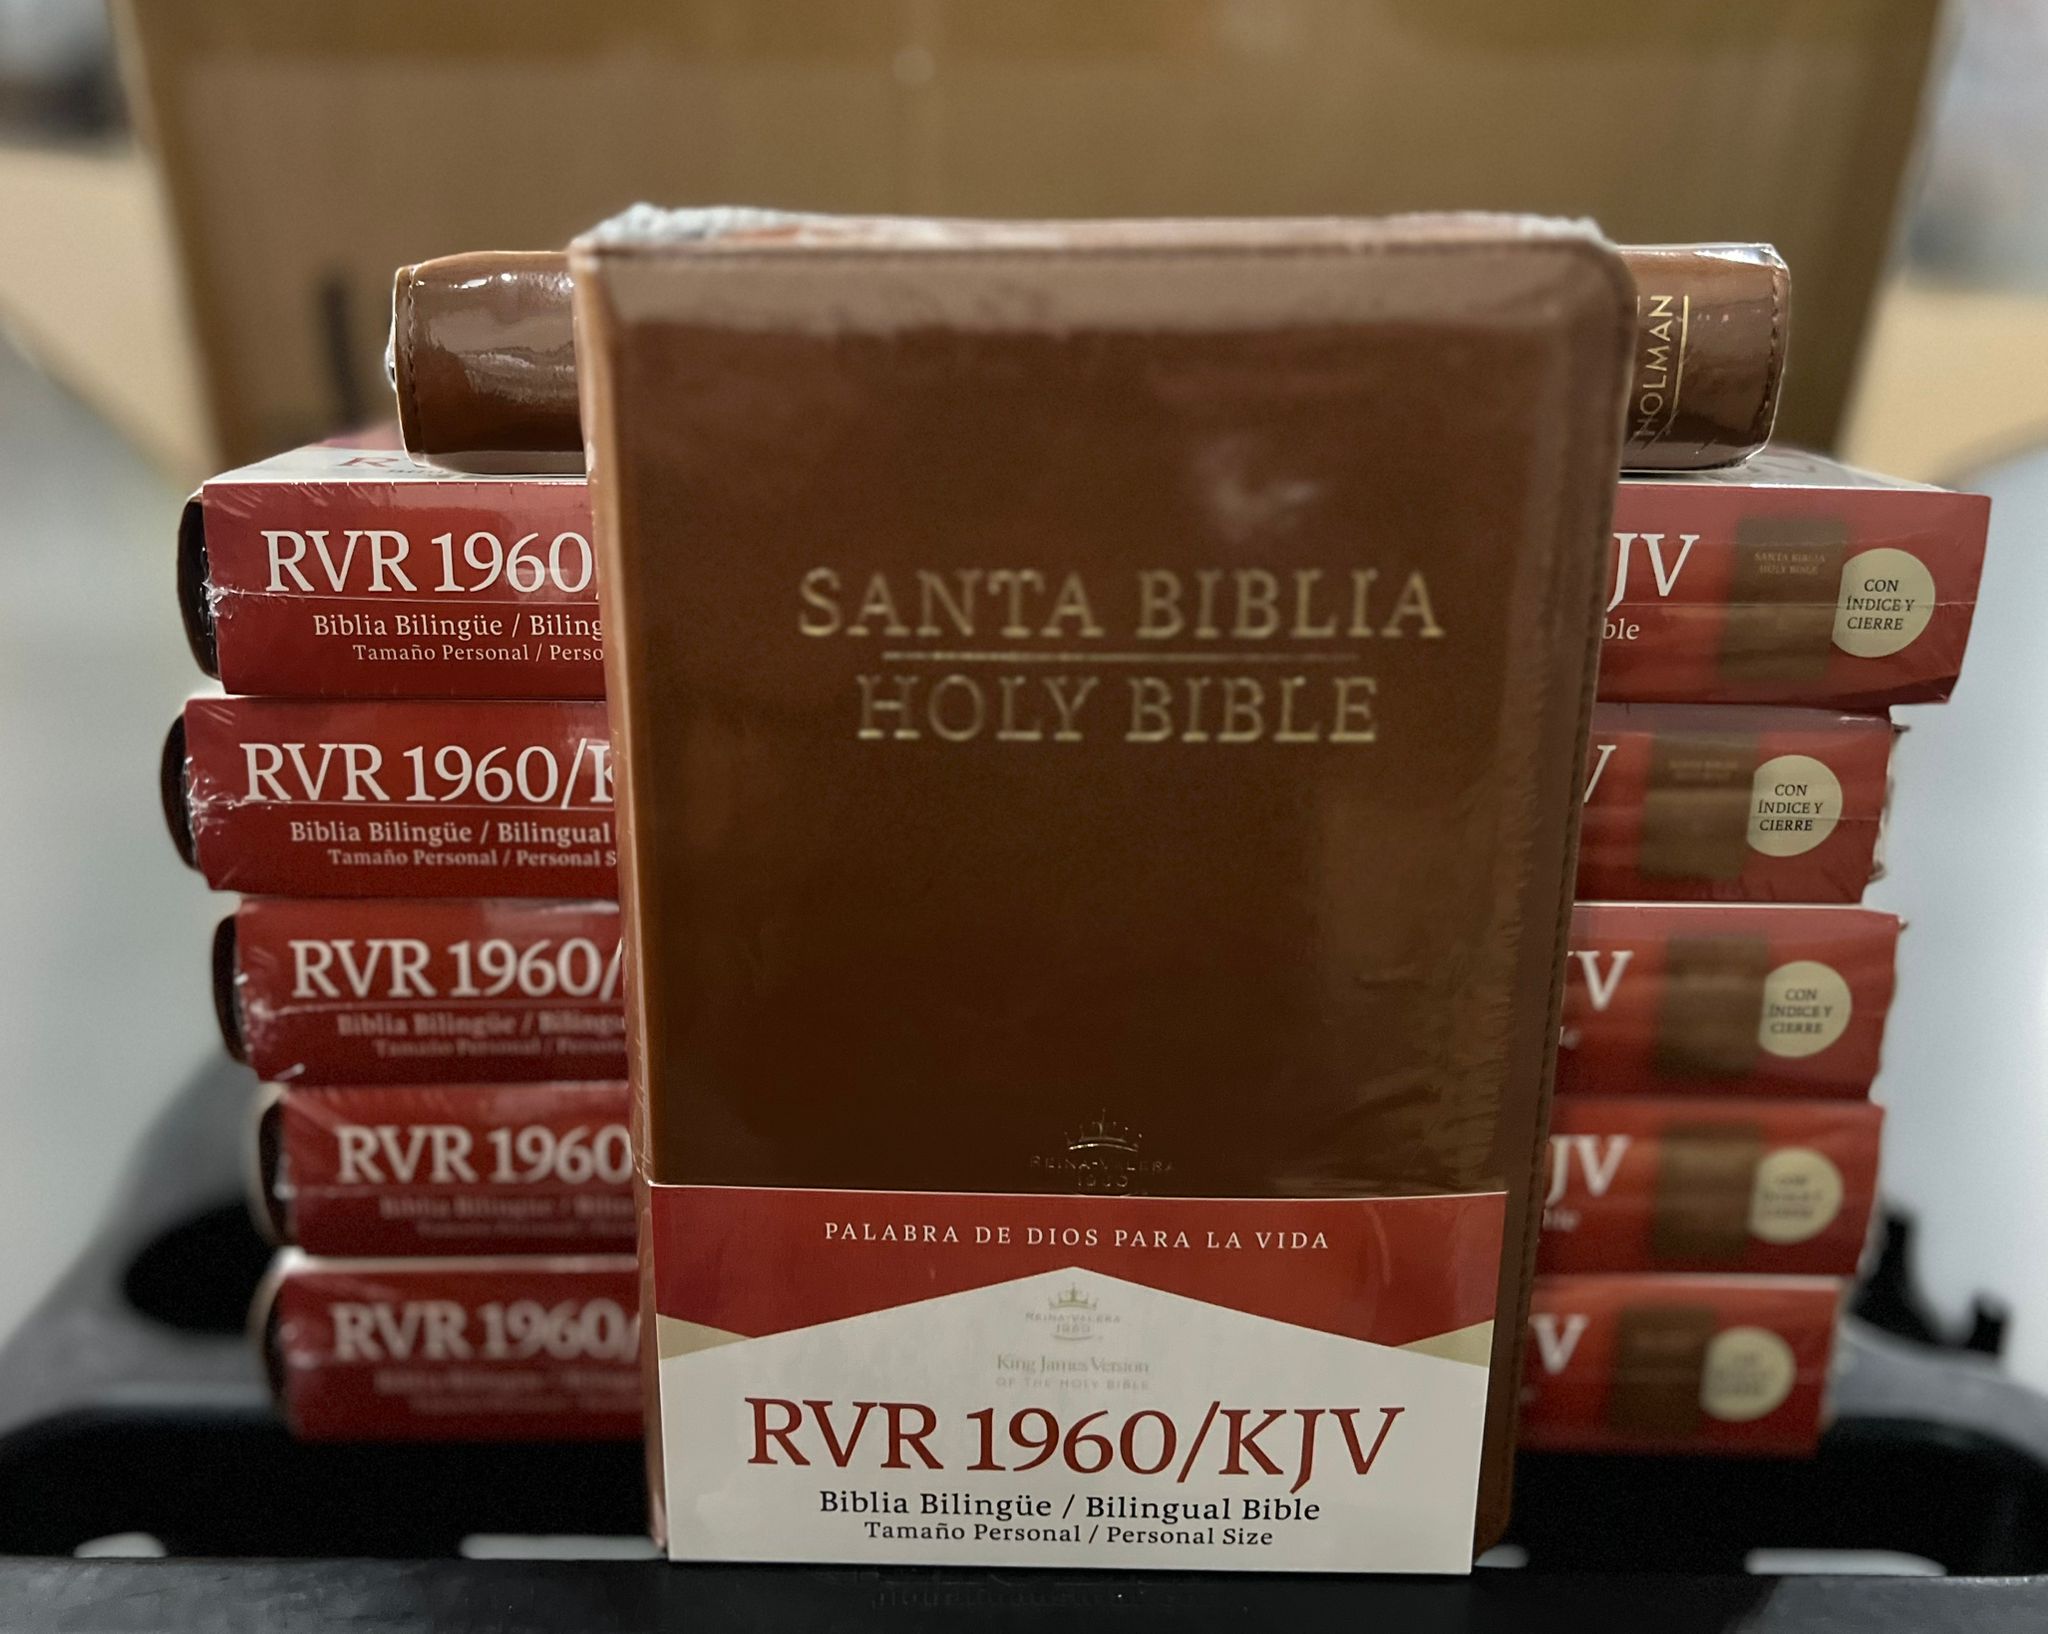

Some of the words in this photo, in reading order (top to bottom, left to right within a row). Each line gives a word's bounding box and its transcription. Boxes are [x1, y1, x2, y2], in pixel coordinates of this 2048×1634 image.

[1636, 295, 1674, 436] HOLMAN
[260, 529, 418, 593] RVR
[430, 530, 599, 600] 1960
[1606, 532, 1700, 613] JV
[1863, 578, 1899, 593] CON
[798, 566, 1105, 638] SANTA
[1134, 567, 1446, 640] BIBLIA
[1846, 595, 1901, 612] ÍNDICE
[1905, 599, 1915, 612] Y
[314, 613, 388, 636] Biblia
[396, 614, 503, 642] Bilingüe
[529, 614, 602, 641] Biling
[1602, 618, 1640, 640] ble
[1847, 616, 1904, 631] CIERRE
[352, 643, 436, 661] Tamaño
[442, 644, 529, 661] Personal
[550, 644, 604, 661] Perso
[854, 673, 1099, 742] HOLY
[1124, 674, 1378, 743] BIBLE
[239, 743, 390, 801] RVR
[403, 737, 614, 810] 1960/K
[1774, 783, 1808, 797] CON
[1758, 799, 1811, 814] ÍNDICE
[1814, 802, 1824, 814] Y
[289, 821, 361, 842] Biblia
[369, 821, 472, 847] Bilingüe
[498, 822, 611, 848] Bilingual
[1759, 819, 1813, 832] CIERRE
[413, 849, 498, 867] Personal
[516, 849, 601, 867] Personal
[288, 938, 438, 999] RVR
[447, 936, 622, 1003] 1960/
[1570, 950, 1635, 1012] V
[1785, 987, 1817, 1001] CON
[335, 1124, 477, 1185] RVR
[486, 1123, 634, 1186] 1960
[1546, 1133, 1631, 1207] JV
[824, 1221, 959, 1243] PALABRA
[975, 1225, 1011, 1245] DE
[1026, 1227, 1099, 1247] DIOS
[1114, 1228, 1190, 1249] PARA
[1206, 1230, 1242, 1250] LA
[1255, 1231, 1330, 1250] VIDA
[331, 1303, 469, 1362] RVR
[481, 1299, 639, 1363] 1960/
[997, 1354, 1036, 1374] King
[1040, 1355, 1088, 1374] James
[1091, 1356, 1150, 1373] Version
[744, 1396, 945, 1471] RVR
[966, 1400, 1406, 1495] 1960/KJV
[820, 1490, 910, 1514] Biblia
[920, 1492, 1053, 1521] Bilingüe
[1085, 1495, 1231, 1525] Bilingual
[1241, 1498, 1321, 1521] Bible
[864, 1520, 966, 1541] Tamaño
[973, 1523, 1081, 1543] Personal
[1106, 1525, 1215, 1545] Personal
[1222, 1526, 1273, 1546] Size
